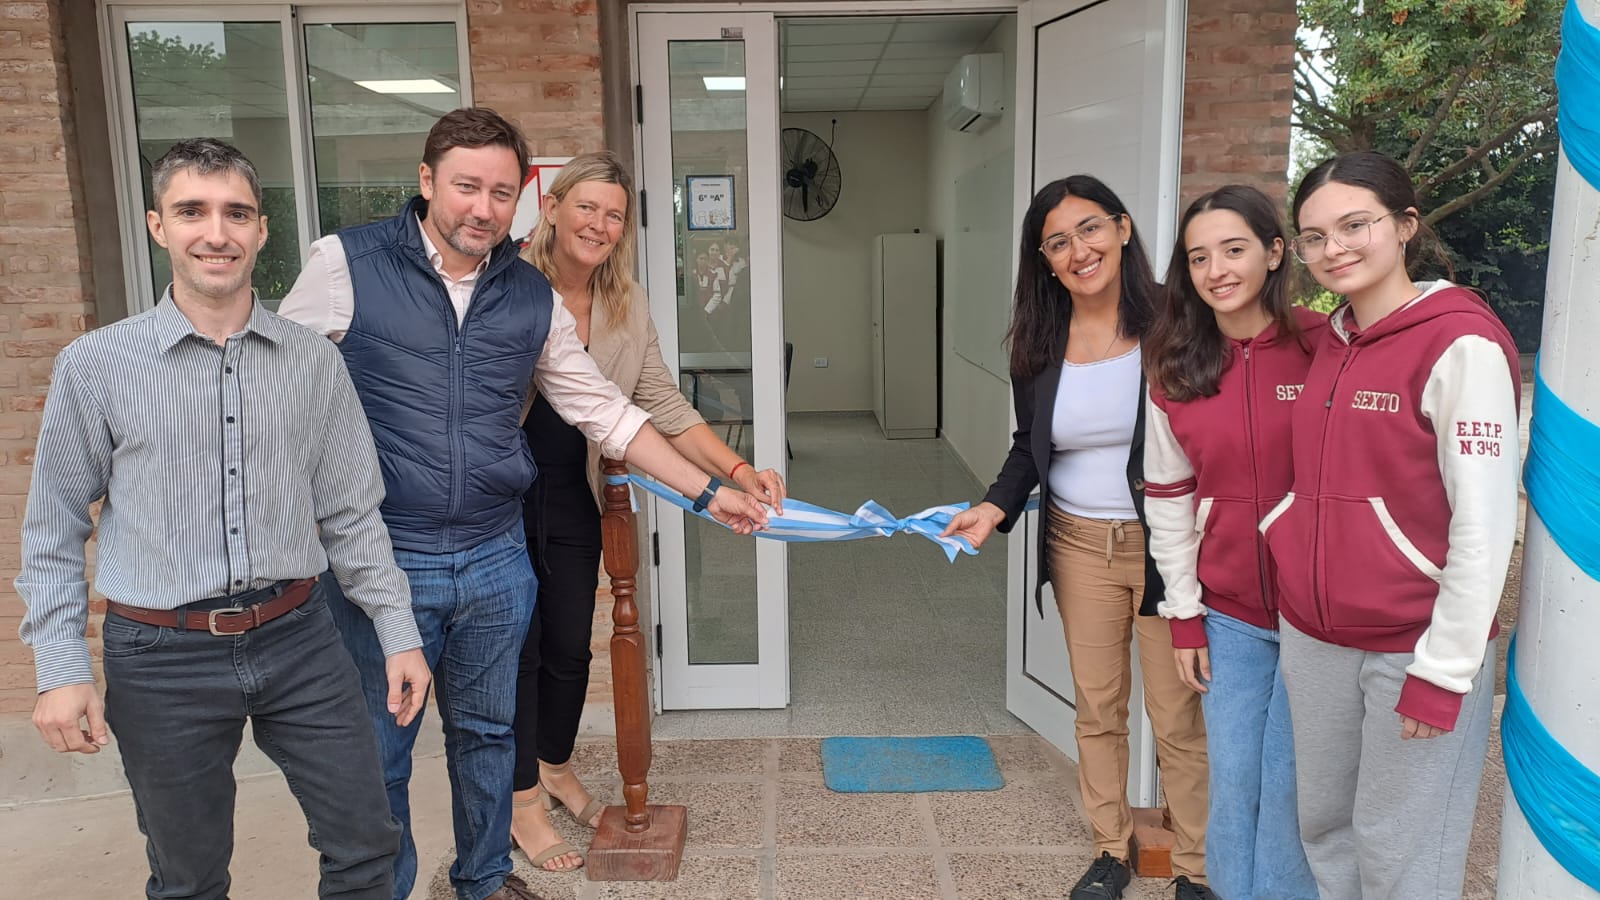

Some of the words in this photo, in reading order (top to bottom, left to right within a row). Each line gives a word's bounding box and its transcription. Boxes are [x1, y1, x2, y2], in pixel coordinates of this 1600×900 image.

[1352, 390, 1400, 413] SEXTO
[1456, 421, 1502, 439] E.E.T.P.
[1459, 440, 1473, 455] N
[1477, 440, 1500, 457] 343
